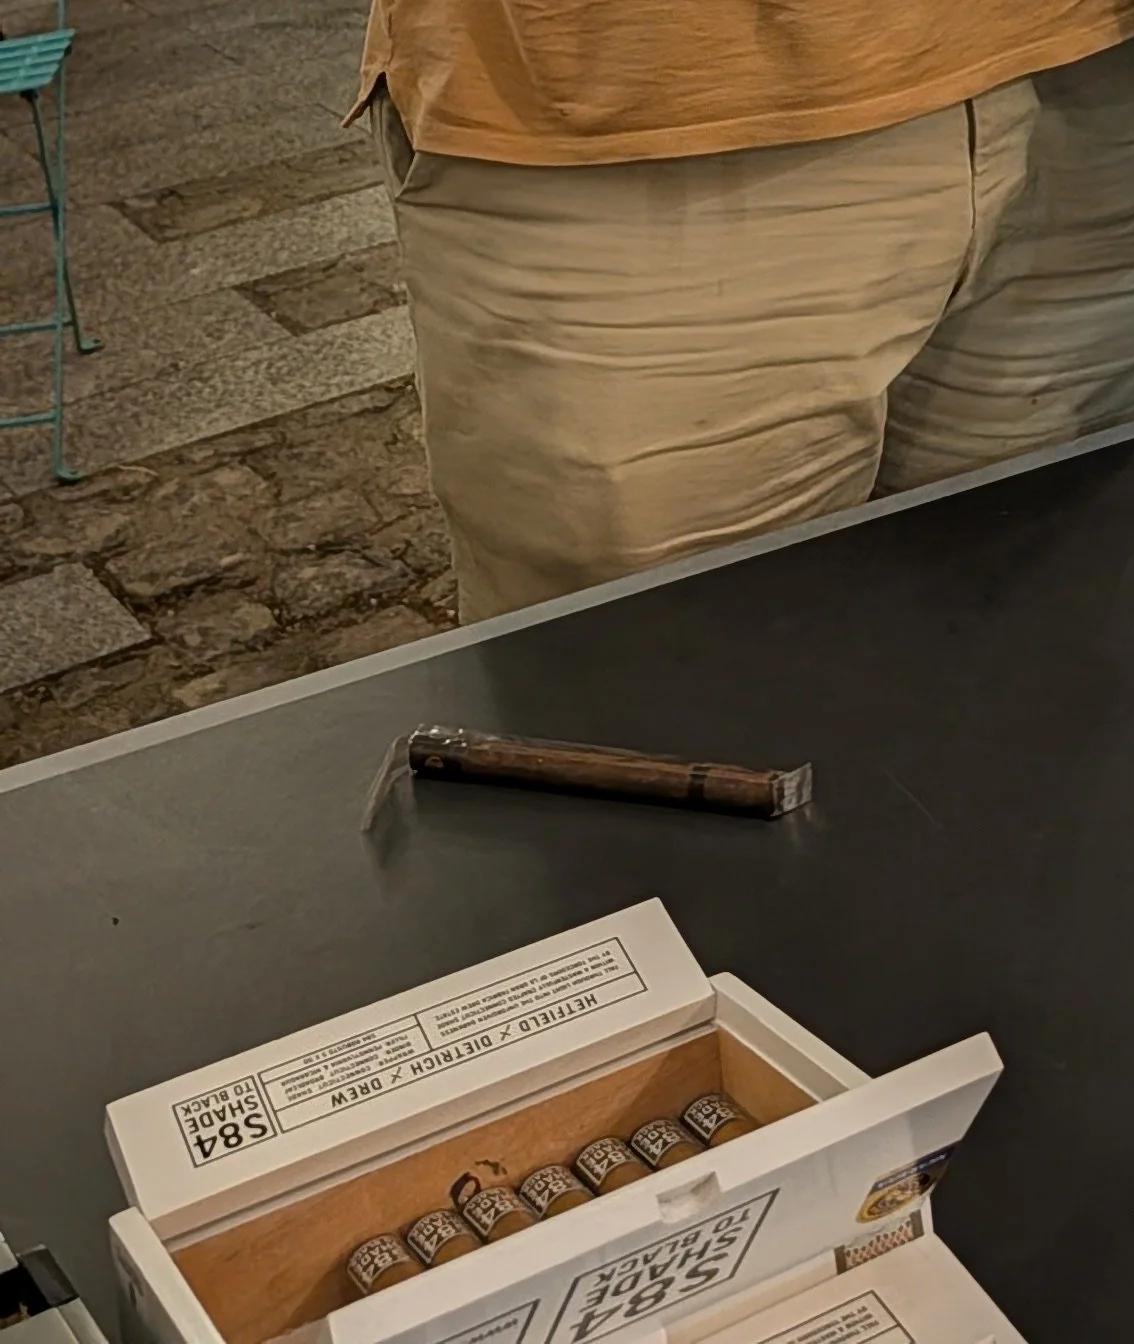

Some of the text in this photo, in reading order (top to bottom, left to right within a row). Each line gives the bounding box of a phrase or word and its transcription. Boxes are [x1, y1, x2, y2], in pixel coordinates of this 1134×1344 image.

[516, 992, 598, 1033] HETFIELD
[409, 1033, 492, 1075] DIETRICH
[179, 1080, 252, 1116] TO BLACK
[327, 1076, 383, 1108] DREW
[183, 1093, 260, 1134] SHADE
[191, 1110, 269, 1161] S84
[600, 1207, 750, 1282] TO BLACK
[586, 1226, 742, 1306] SHADE
[569, 1252, 727, 1343] S84
